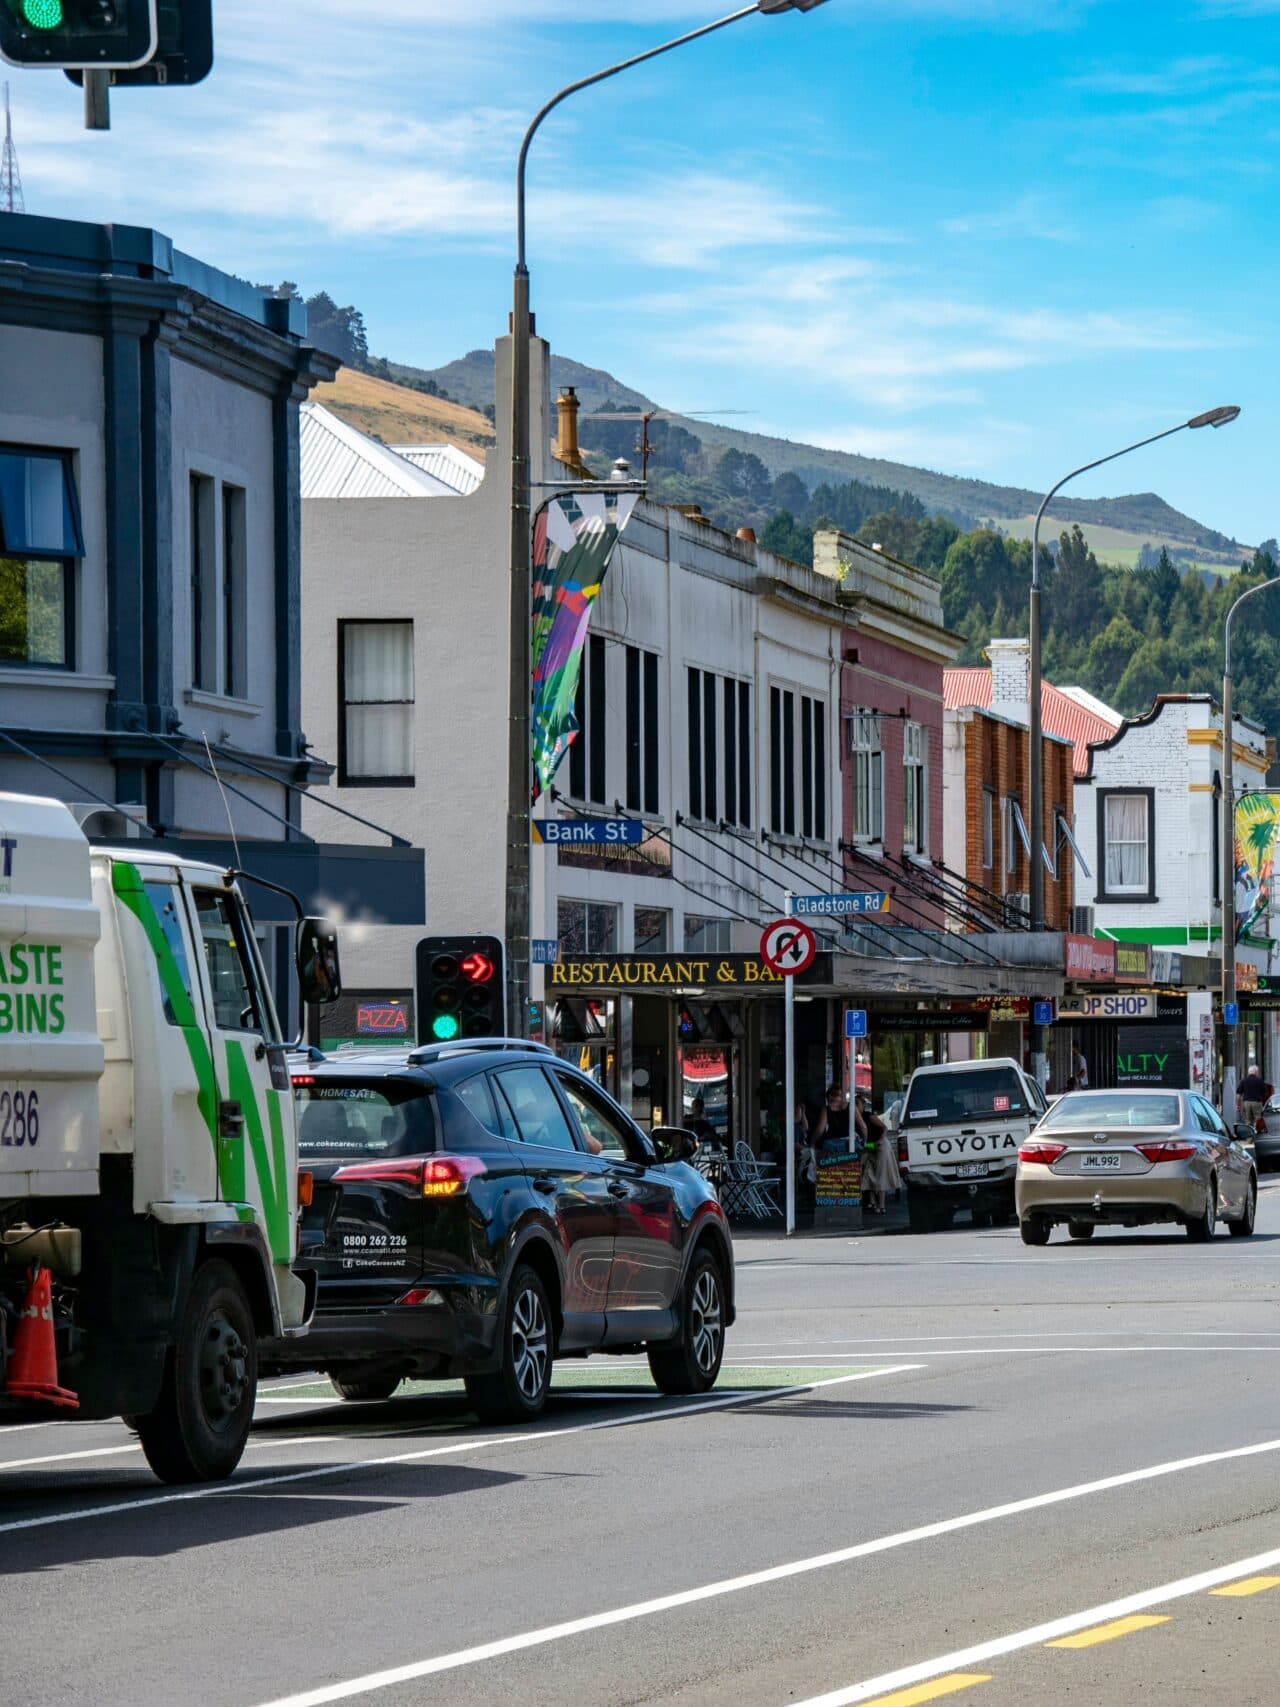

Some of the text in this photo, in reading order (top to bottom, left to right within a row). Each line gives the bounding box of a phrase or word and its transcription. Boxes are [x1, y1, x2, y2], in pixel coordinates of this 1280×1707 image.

[546, 822, 628, 841] Bank St
[797, 895, 880, 912] Gladstone Rd
[548, 944, 557, 960] Rd
[551, 961, 784, 983] RESTAURANT & BA
[0, 993, 65, 1034] BINS
[1104, 997, 1147, 1015] SHOP
[357, 1009, 407, 1028] PIZZA
[852, 1012, 859, 1020] P
[952, 1015, 972, 1024] Coffee
[320, 1089, 377, 1099] HOMESAFE
[922, 1134, 1016, 1156] TOYOTA
[343, 1235, 407, 1246] 0800 262 226
